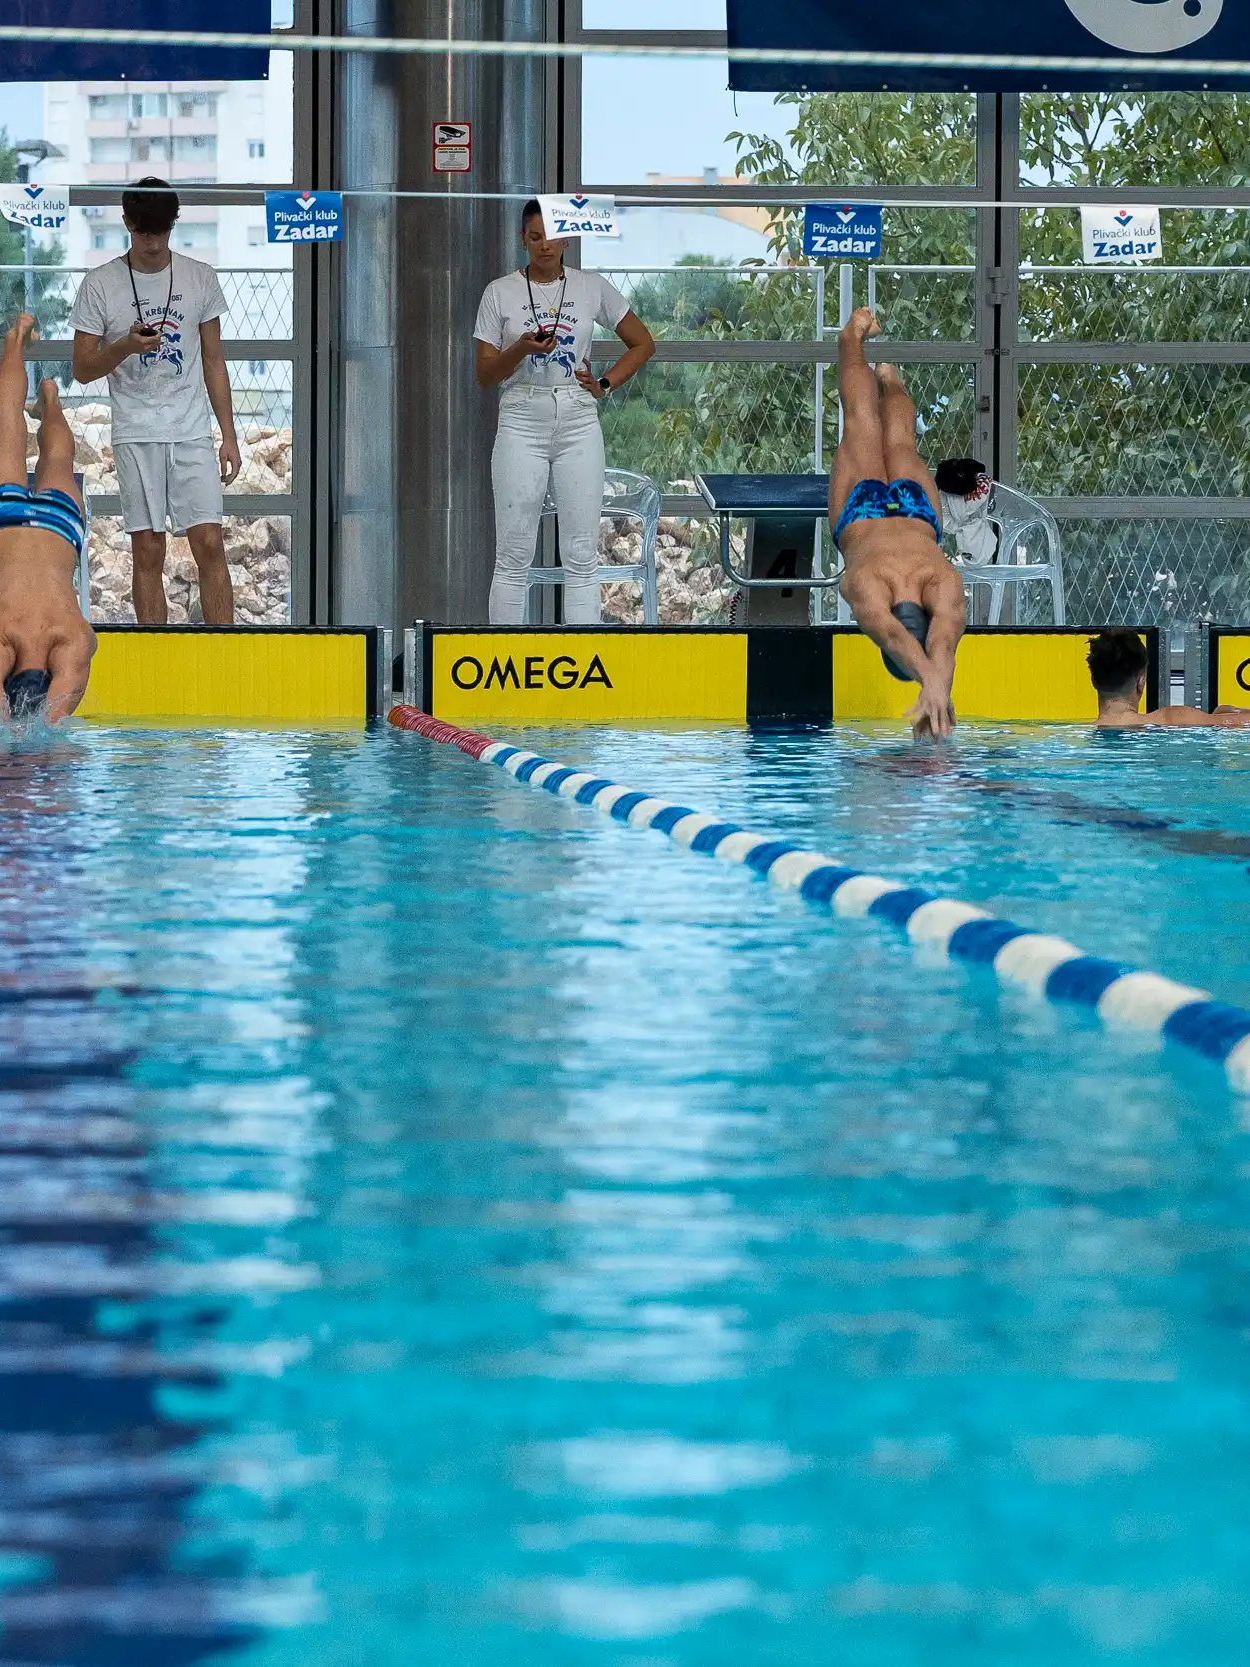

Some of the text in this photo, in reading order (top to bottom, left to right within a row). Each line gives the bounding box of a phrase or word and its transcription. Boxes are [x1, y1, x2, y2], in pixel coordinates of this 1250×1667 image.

[43, 200, 65, 210] klub
[274, 210, 338, 222] Plivački klub
[590, 209, 611, 219] klub
[274, 224, 338, 240] Zadar
[553, 220, 613, 233] Zadar
[812, 222, 876, 235] Plivački klub
[1092, 227, 1156, 239] Plivački klub
[811, 236, 876, 253] Zadar
[1093, 240, 1157, 257] Zadar
[766, 549, 797, 598] 4
[451, 654, 614, 690] OMEGA
